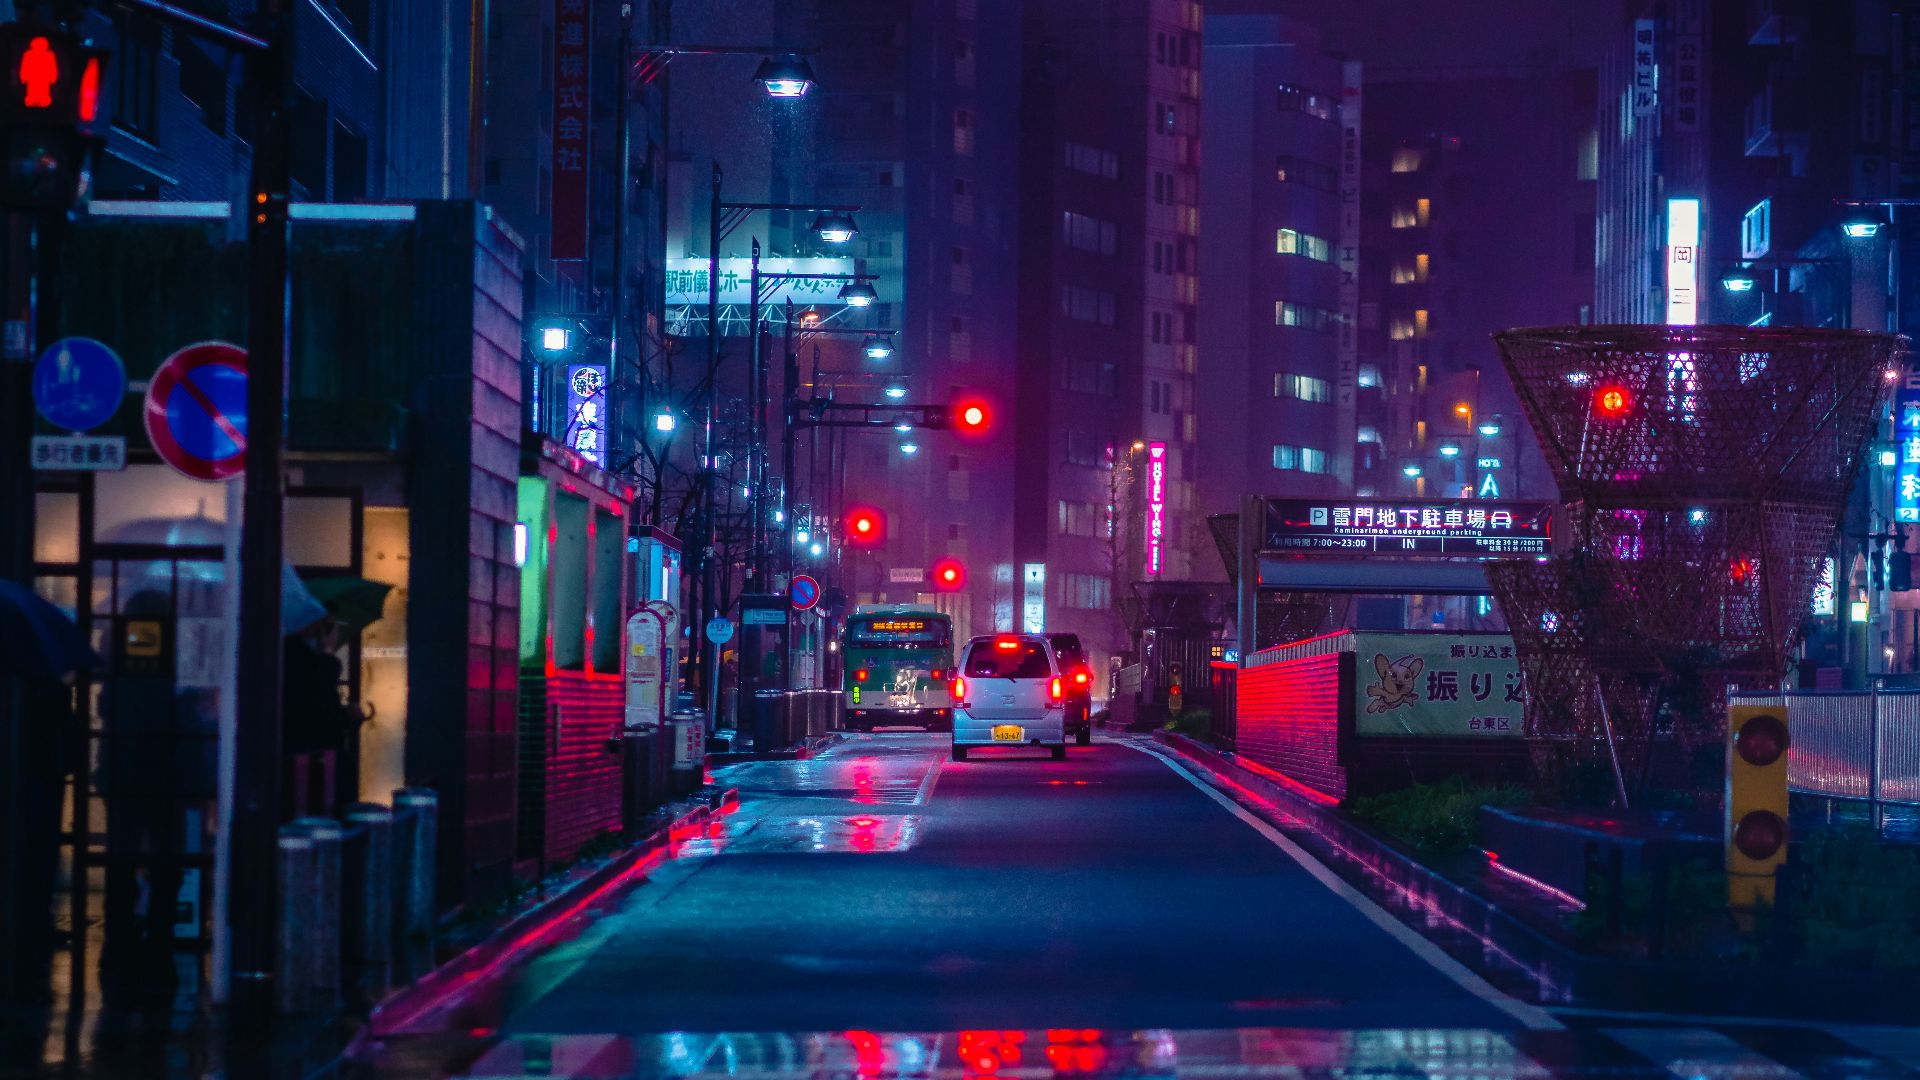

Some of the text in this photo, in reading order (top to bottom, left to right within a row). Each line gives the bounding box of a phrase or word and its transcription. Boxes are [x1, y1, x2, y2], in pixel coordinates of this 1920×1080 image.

[1152, 461, 1163, 501] HOTEL
[1151, 503, 1163, 537] WING
[1333, 507, 1486, 528] 雷門地下駐車場
[1335, 527, 1482, 537] Kaminarimon underground parking
[1402, 538, 1415, 549] IN
[1450, 644, 1519, 659] 振り込ま
[1468, 717, 1510, 731] 台東区
